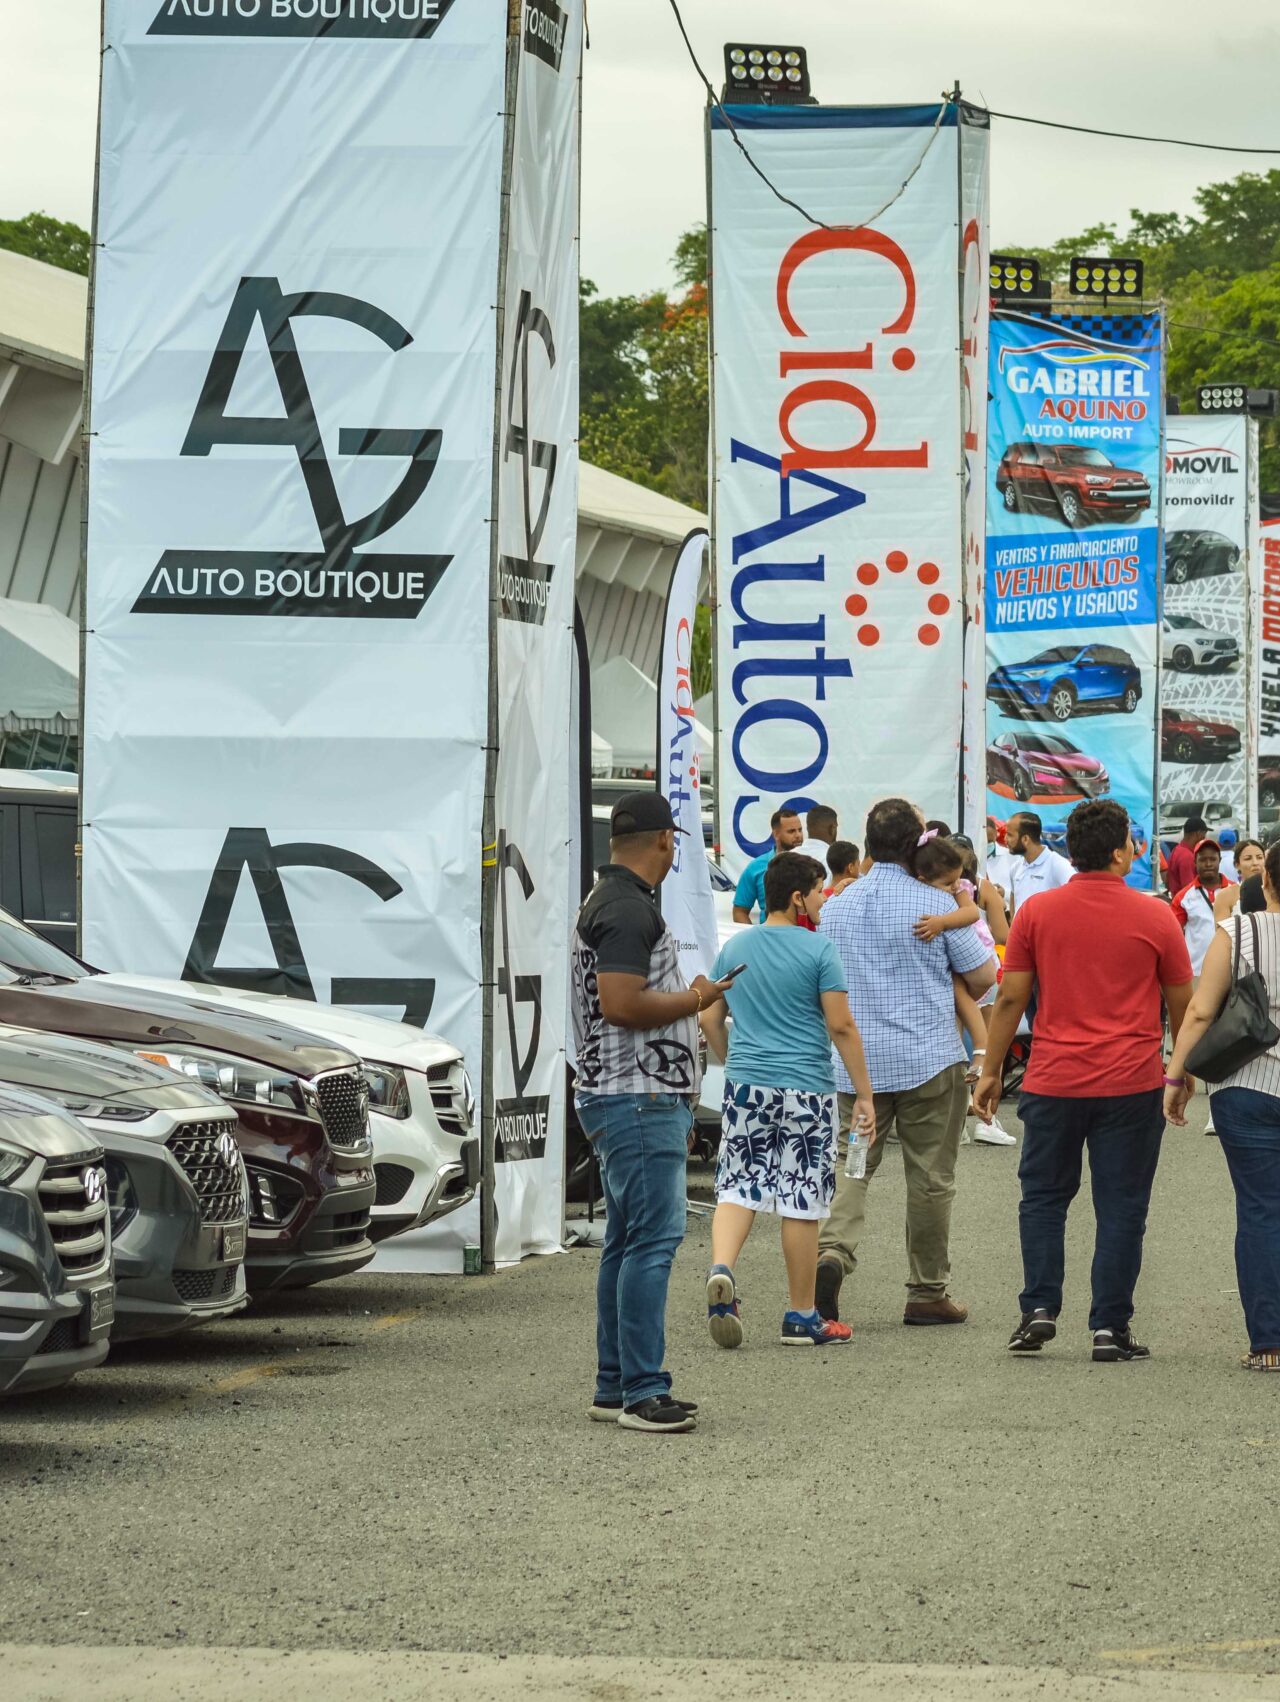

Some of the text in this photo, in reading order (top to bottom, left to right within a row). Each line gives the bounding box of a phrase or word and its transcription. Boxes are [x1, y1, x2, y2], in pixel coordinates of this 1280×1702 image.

[1006, 366, 1151, 397] GABRIEL
[1039, 397, 1149, 423] AQUINO
[1022, 423, 1133, 440] AUTO IMPORT
[996, 546, 1037, 567] VENTAS
[1040, 545, 1048, 562] Y
[150, 567, 425, 603] AUTO BOUTIQUE
[994, 555, 1140, 599] VEHICULOS
[996, 588, 1139, 625] NUEVOS Y USADOS
